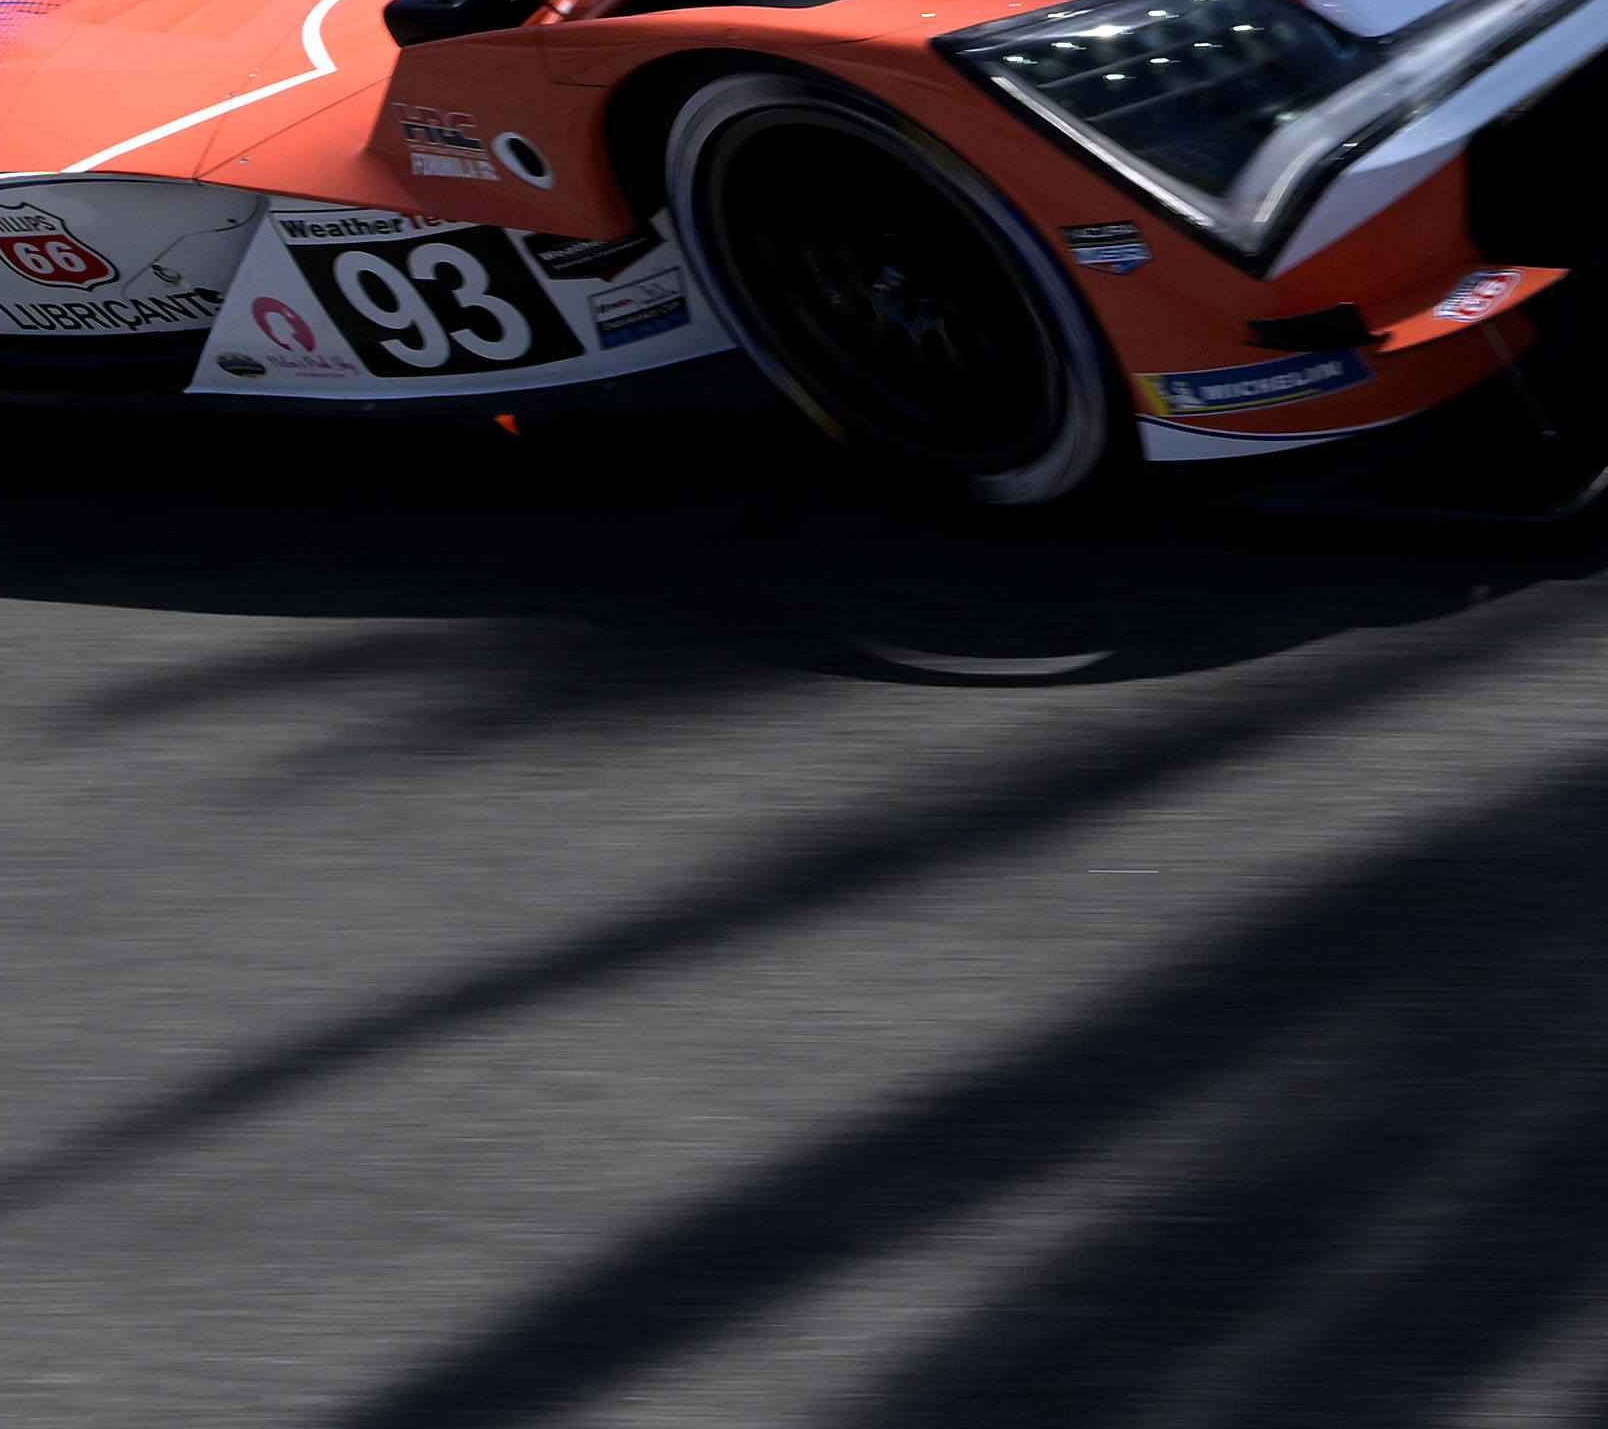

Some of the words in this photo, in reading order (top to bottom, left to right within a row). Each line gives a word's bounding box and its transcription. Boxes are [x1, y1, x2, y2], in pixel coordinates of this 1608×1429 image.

[279, 213, 459, 239] WeatherTe
[12, 240, 89, 276] 66
[332, 242, 534, 369] 93
